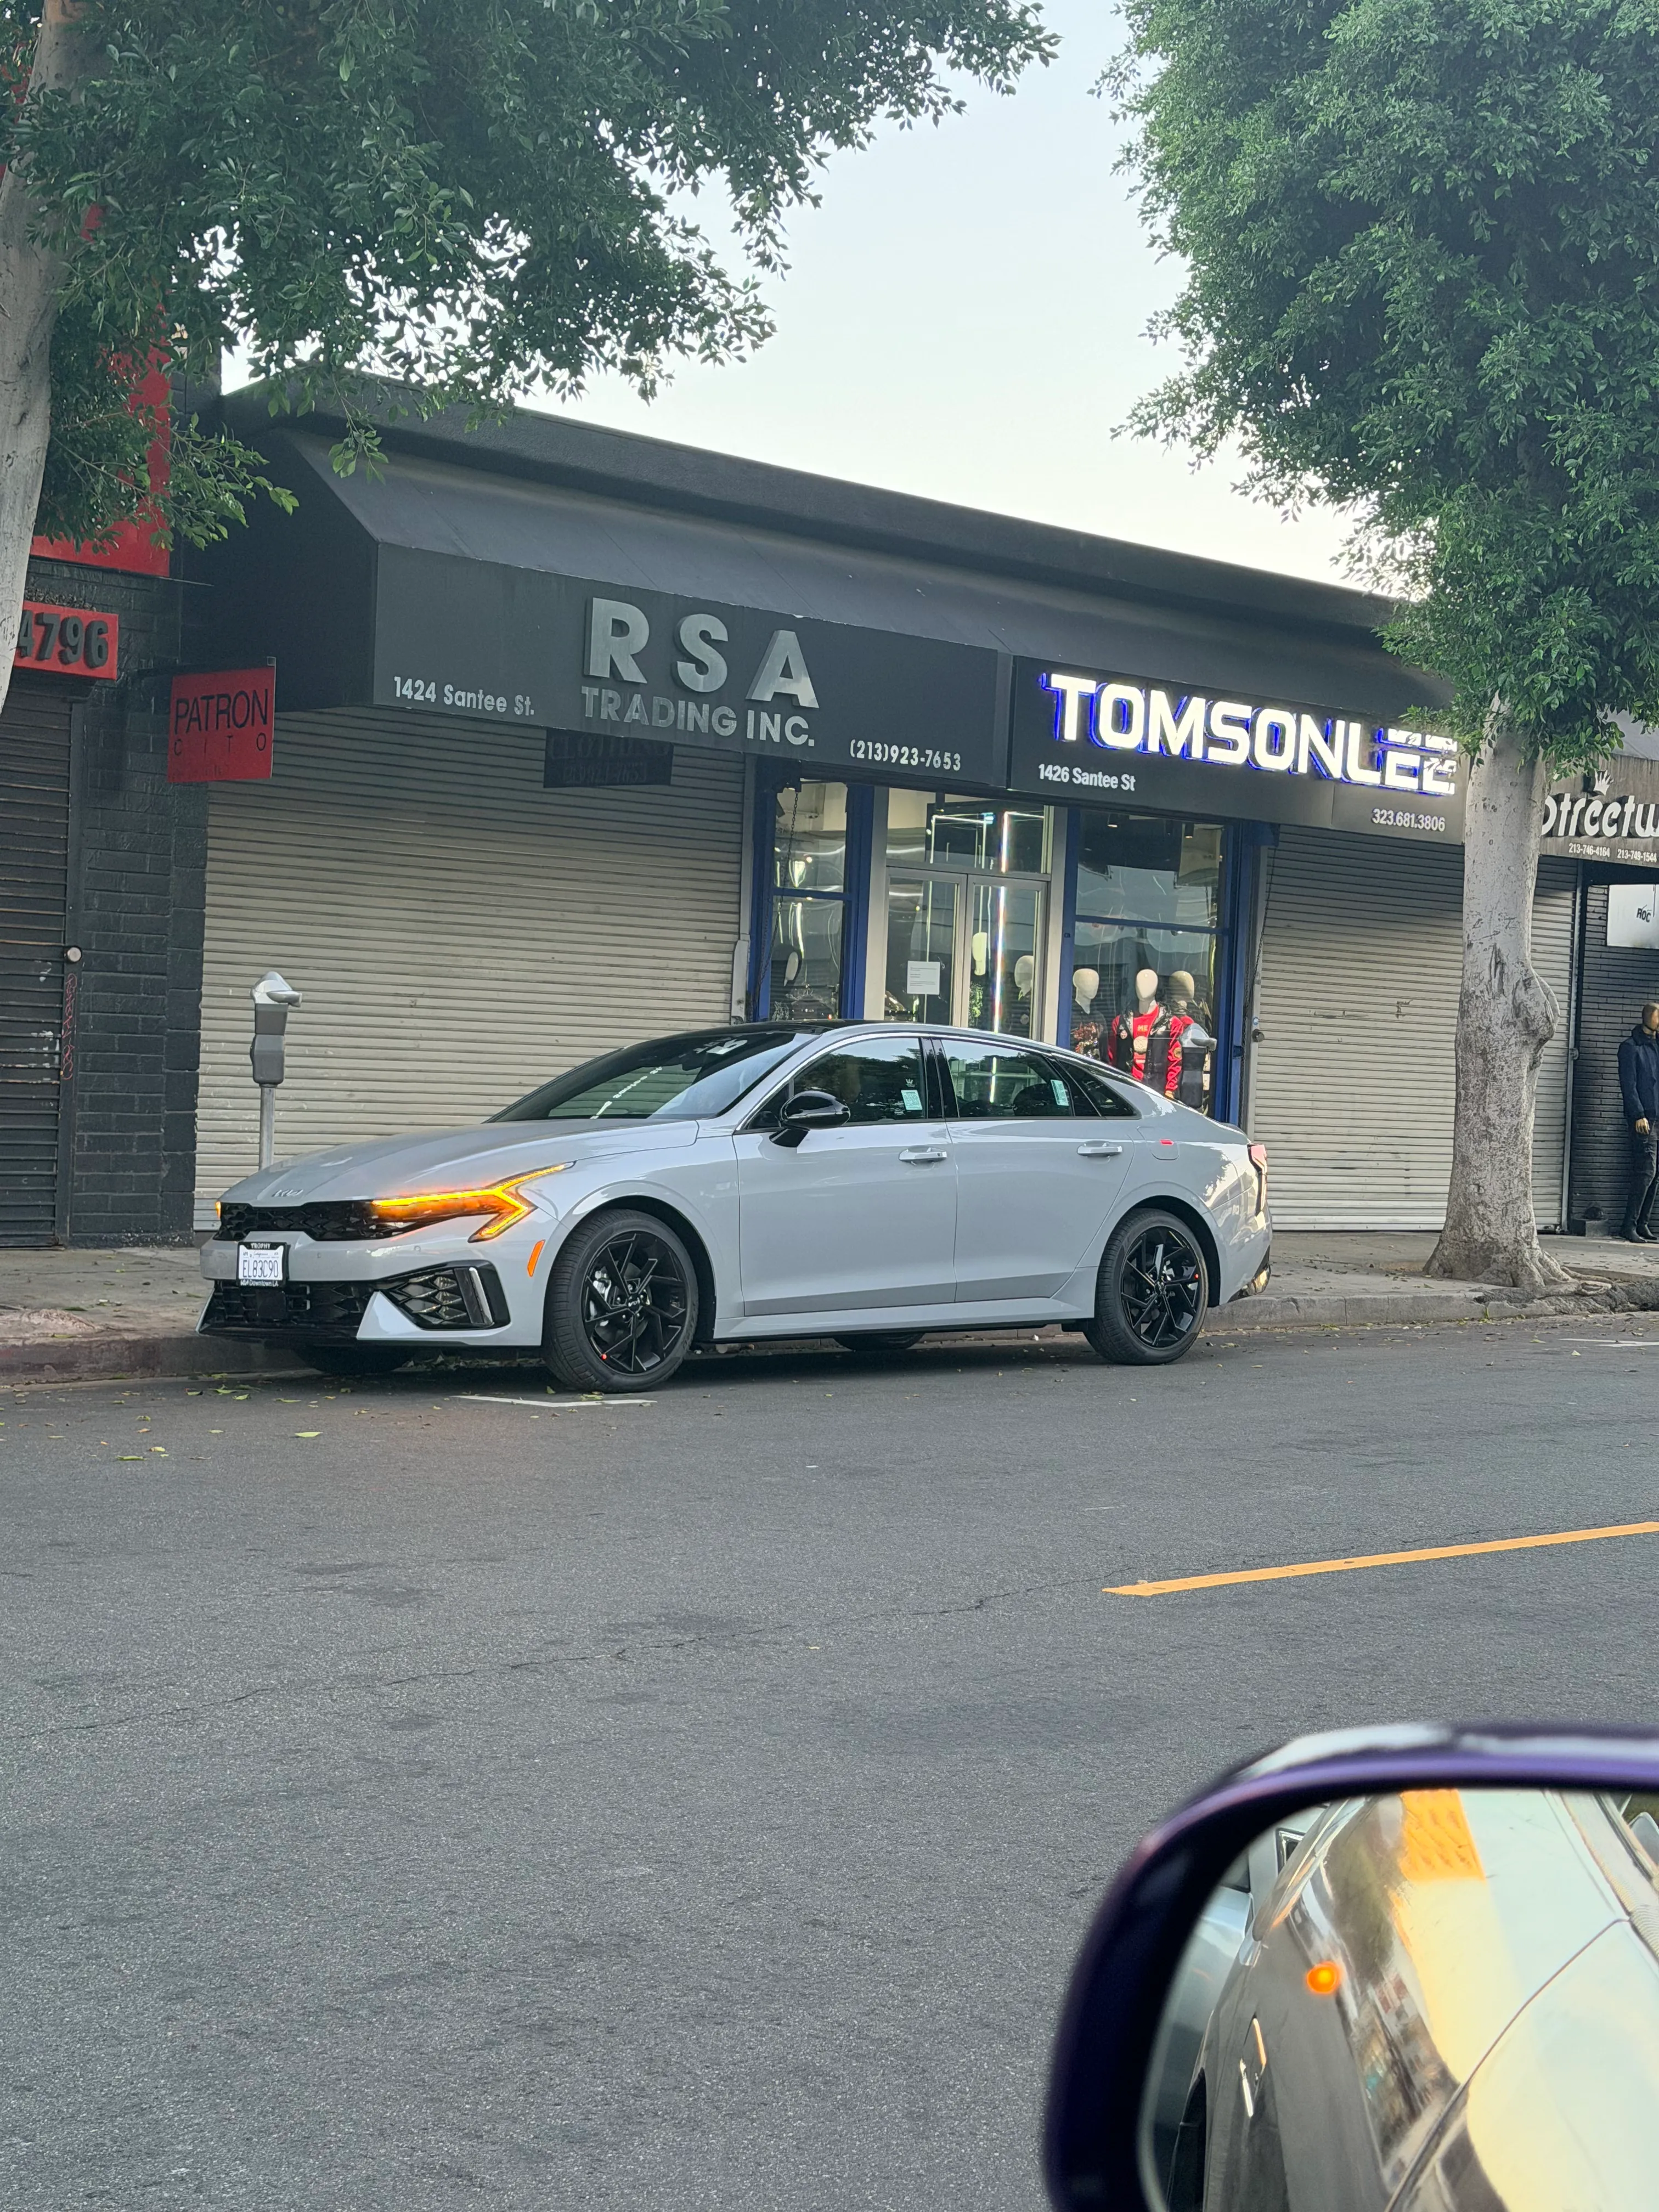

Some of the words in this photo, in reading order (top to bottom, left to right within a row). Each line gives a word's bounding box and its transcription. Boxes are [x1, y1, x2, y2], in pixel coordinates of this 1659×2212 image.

[18, 610, 109, 669] 4796
[174, 689, 268, 734] PATRON
[394, 676, 436, 702] 1424
[443, 684, 507, 712] Santee
[514, 695, 534, 716] St.
[581, 686, 737, 737] TRADING
[747, 709, 815, 747] INC.
[1040, 673, 1458, 795] TOMSONLEE
[850, 739, 961, 771] (213)923-7653
[1039, 764, 1070, 783] 1426
[1072, 767, 1119, 789] Santee
[1120, 774, 1136, 791] St
[1372, 808, 1446, 832] 323.681.3806
[1568, 843, 1610, 857] 213-746-4164
[1617, 848, 1657, 863] 213-749-1544
[242, 1259, 279, 1278] EL83C90
